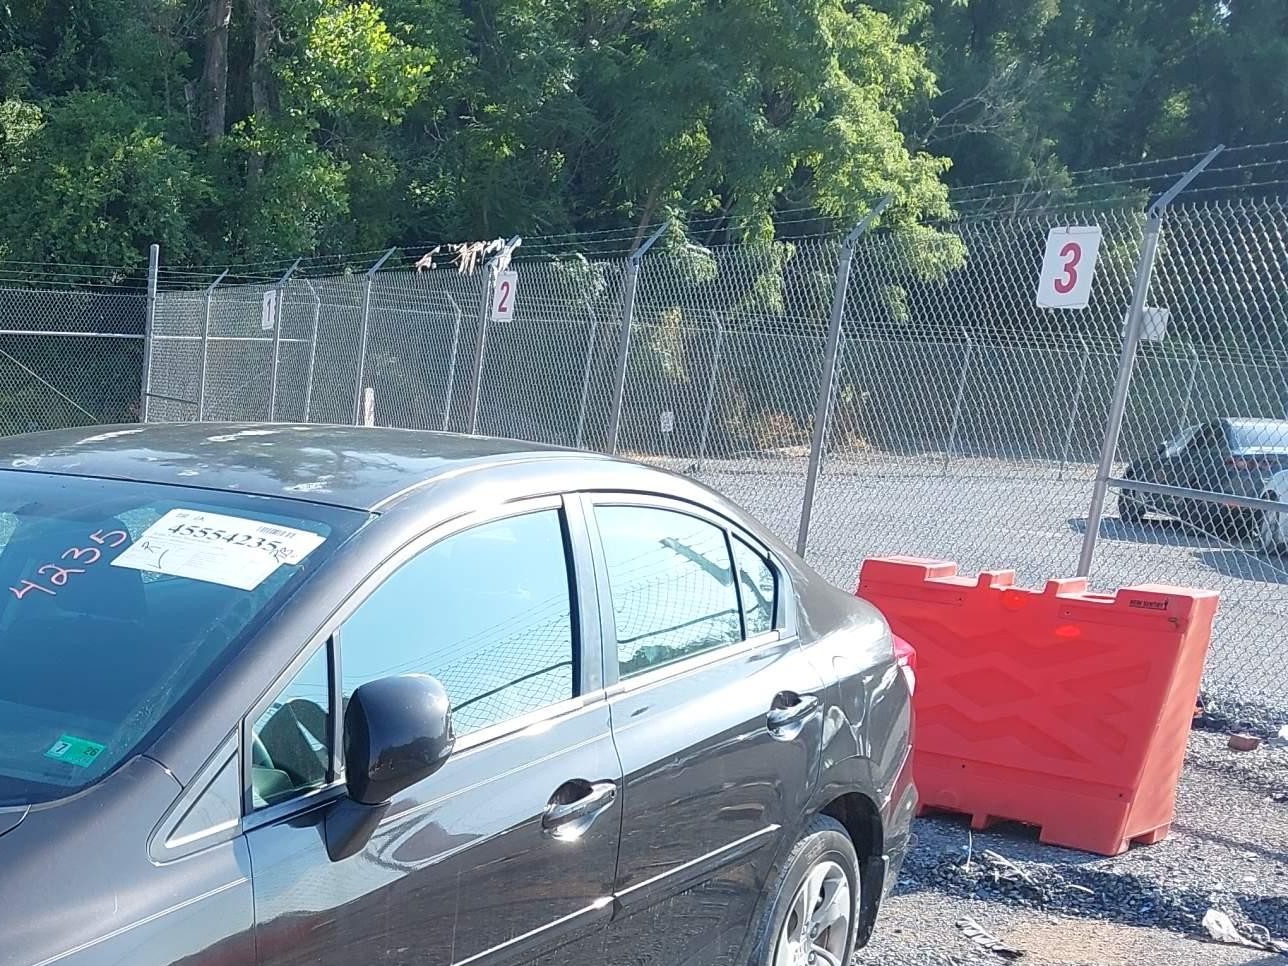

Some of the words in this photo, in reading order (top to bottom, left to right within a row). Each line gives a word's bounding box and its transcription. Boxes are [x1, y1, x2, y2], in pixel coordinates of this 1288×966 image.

[1054, 242, 1082, 294] 3
[497, 281, 510, 312] 2
[168, 523, 283, 551] 45554235
[8, 528, 128, 599] 4235
[55, 742, 69, 753] 7
